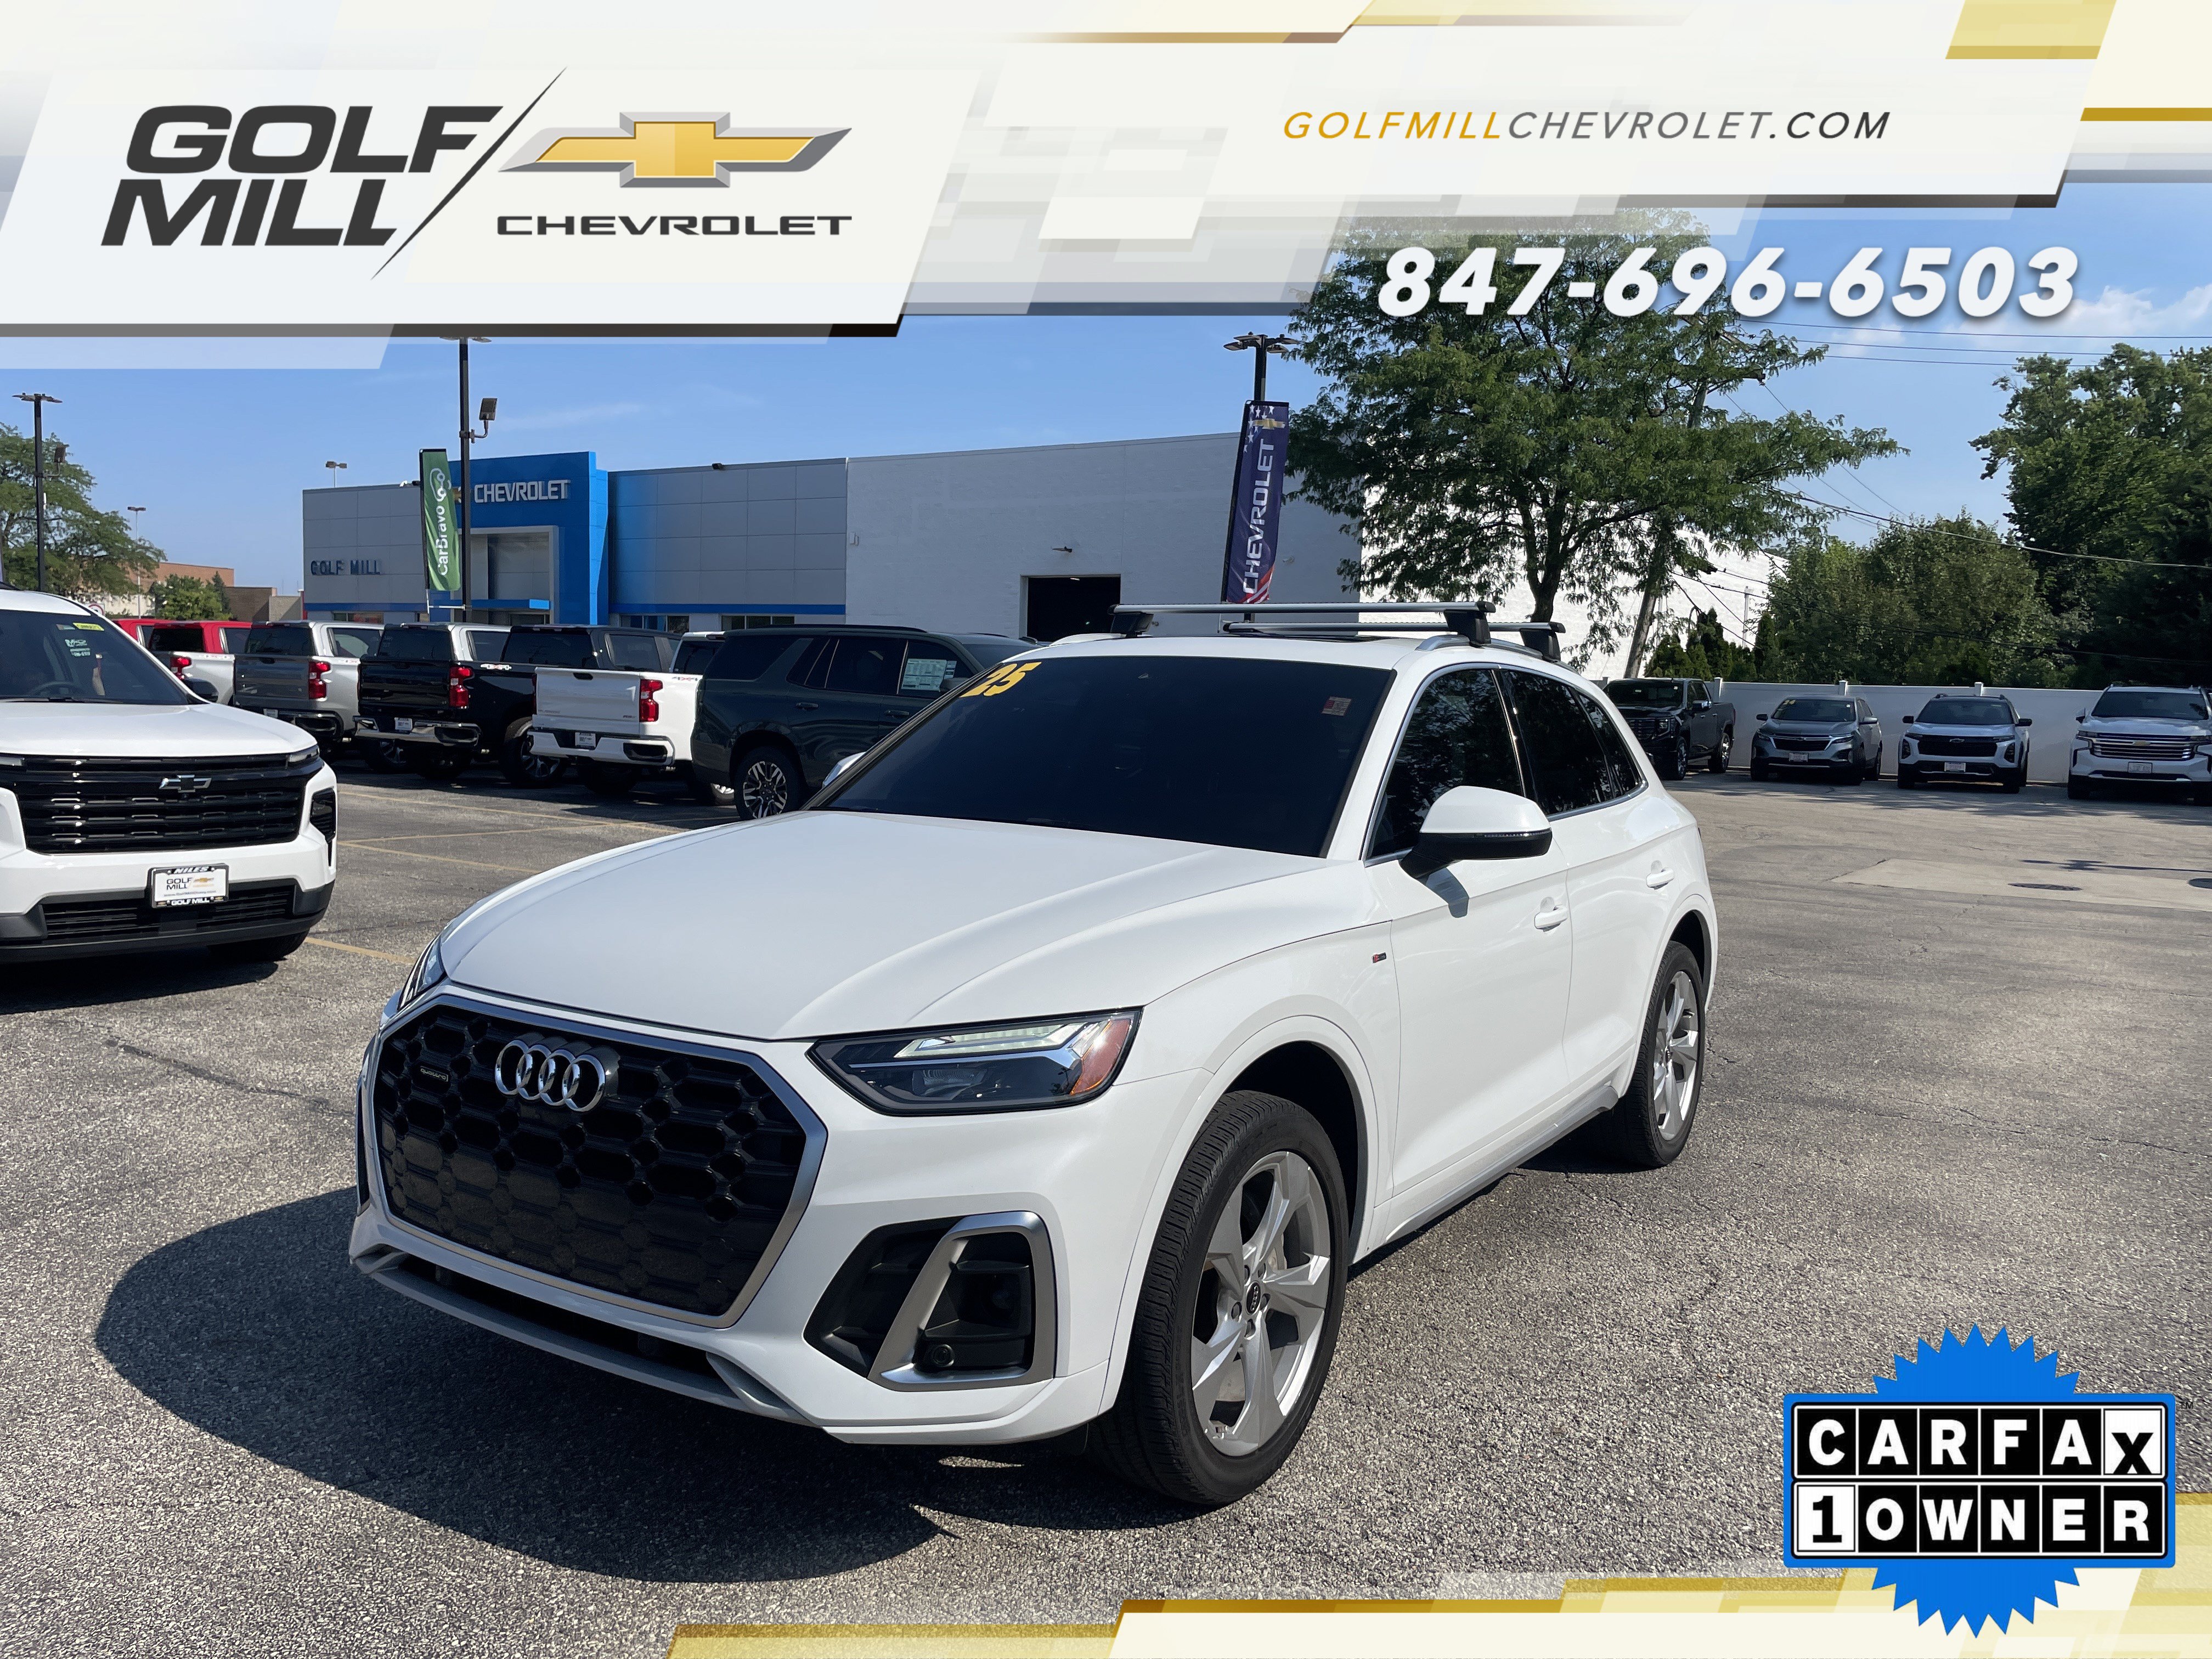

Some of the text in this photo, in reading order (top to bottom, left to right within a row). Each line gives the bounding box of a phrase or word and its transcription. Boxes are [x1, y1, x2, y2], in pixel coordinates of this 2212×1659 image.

[474, 479, 571, 503] CHEVROLET
[1243, 438, 1274, 595] CHEVROLET
[435, 505, 448, 576] CarBravo
[311, 560, 381, 575] GOLF MILL
[960, 662, 1042, 696] 25
